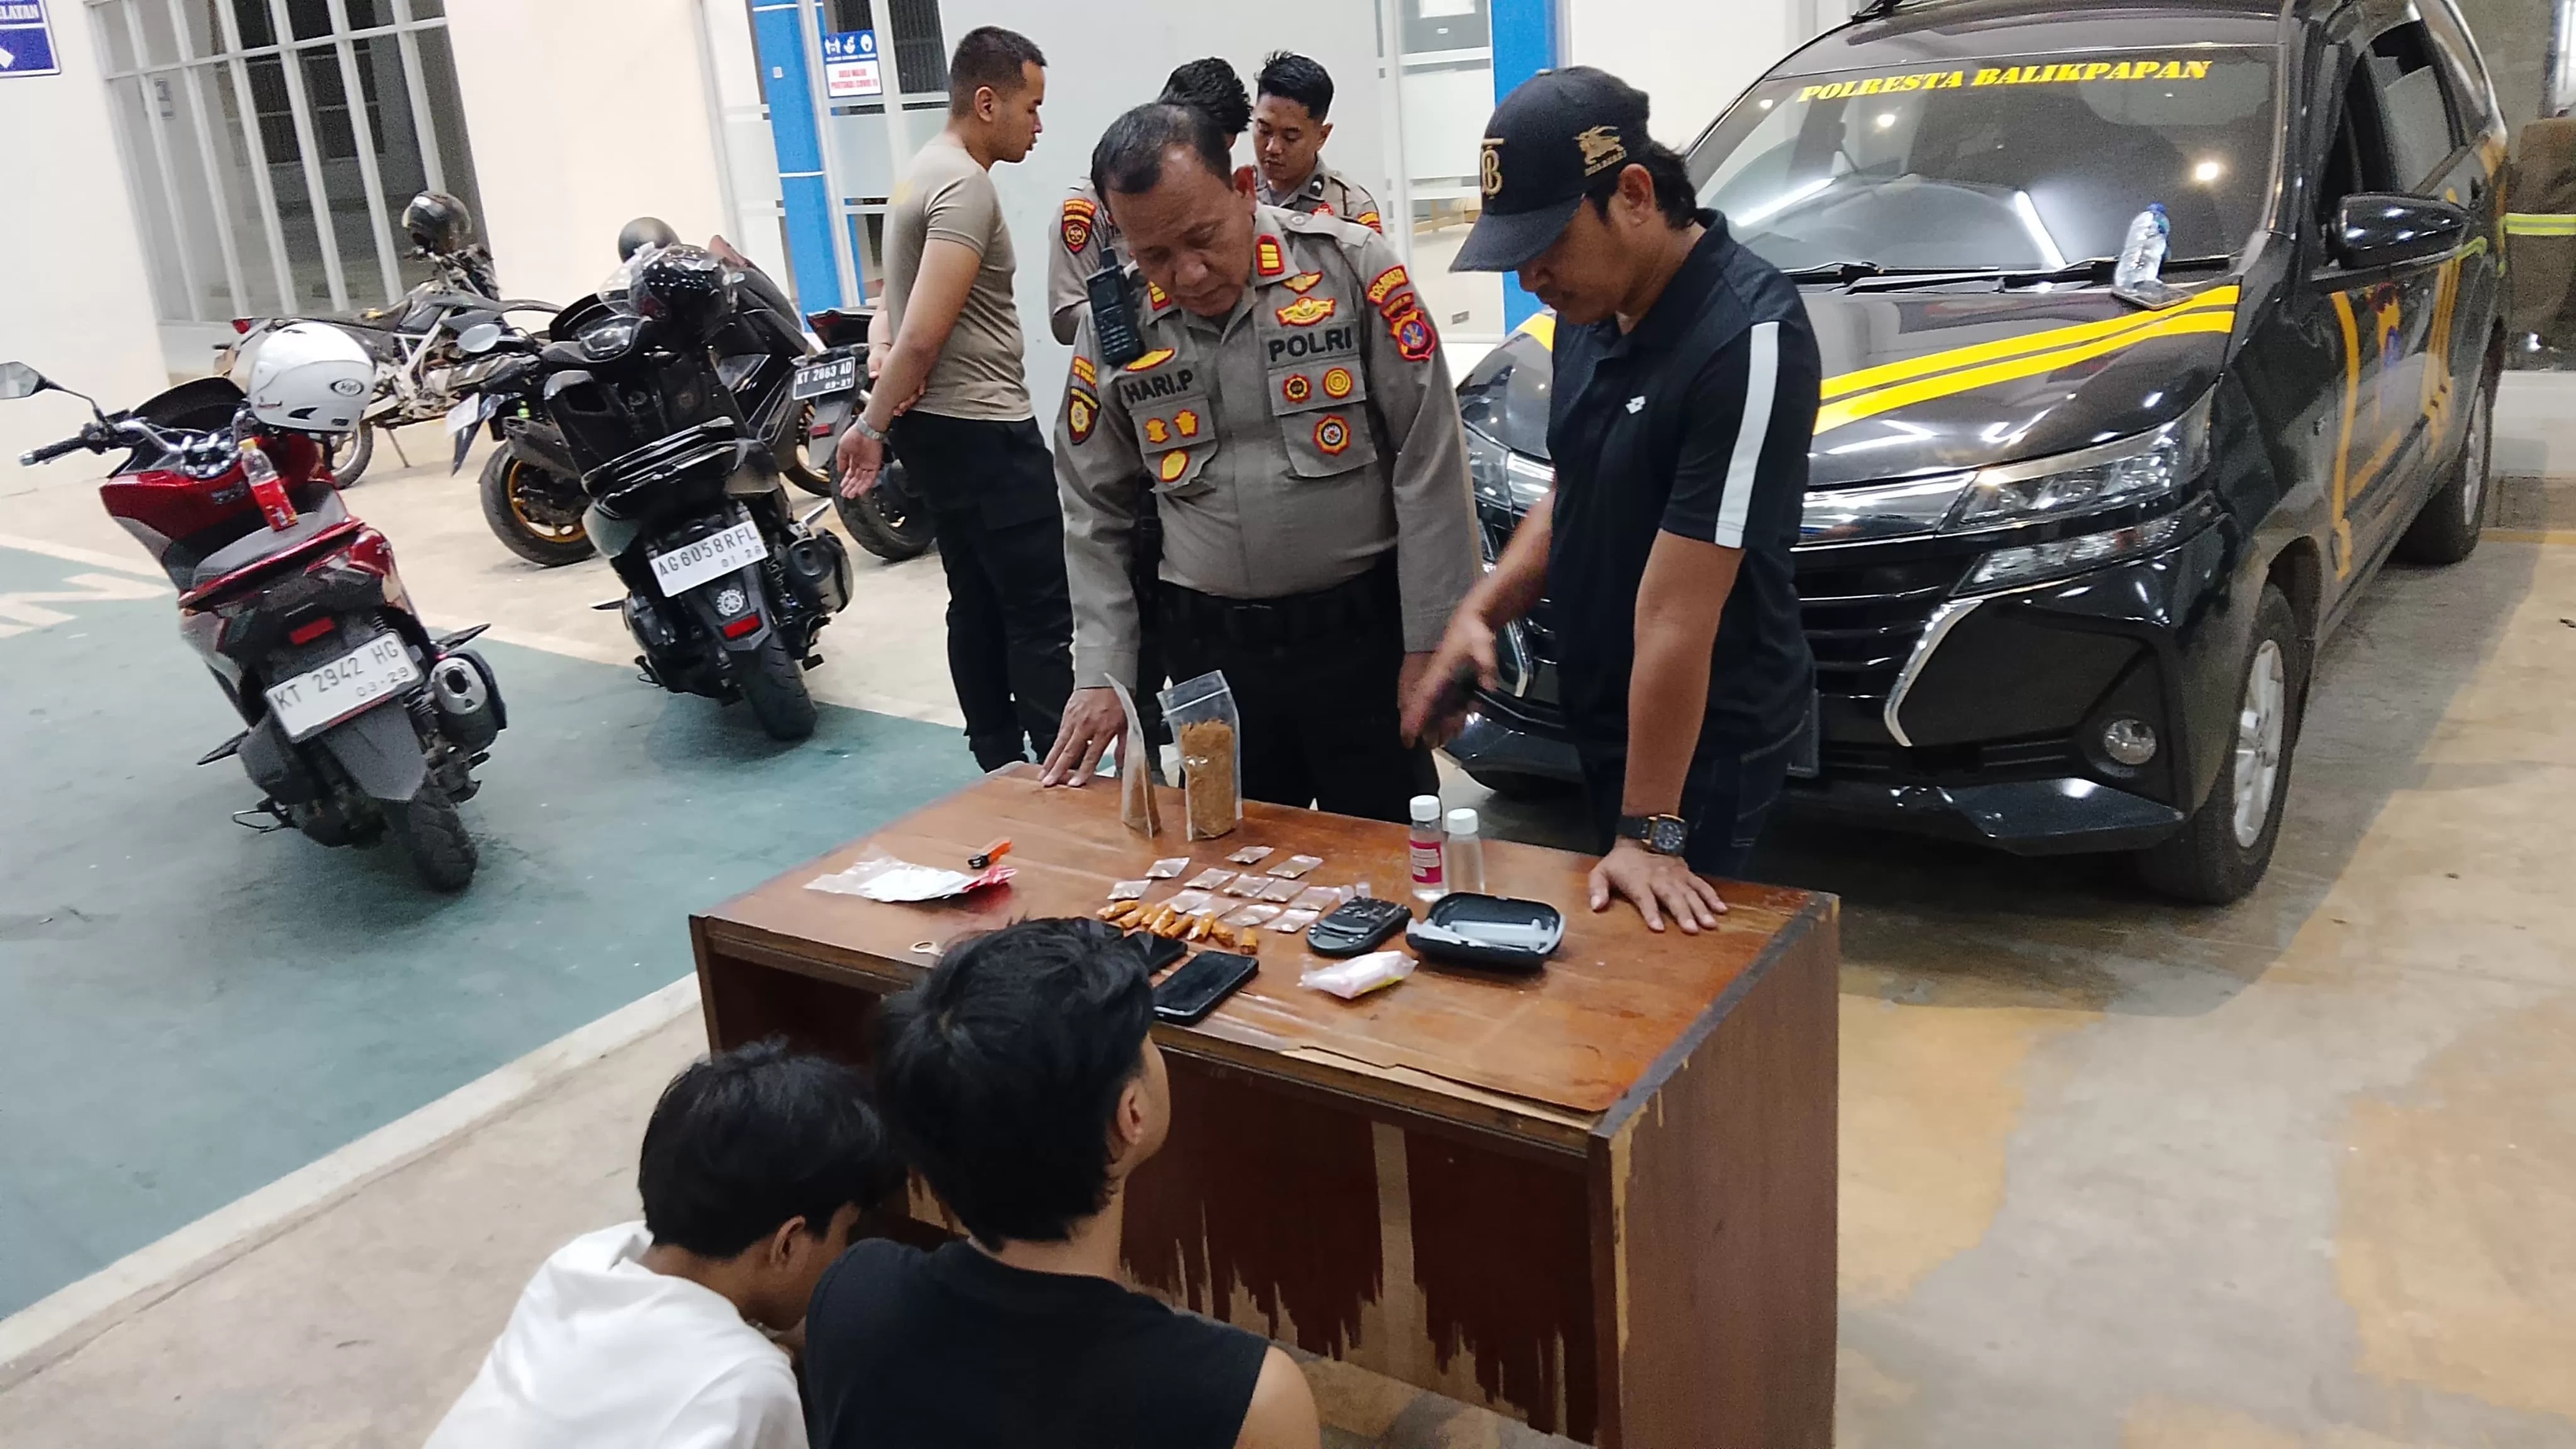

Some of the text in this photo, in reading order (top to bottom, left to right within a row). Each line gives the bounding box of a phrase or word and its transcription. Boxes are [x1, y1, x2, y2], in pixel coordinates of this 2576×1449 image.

[1796, 60, 2214, 103] POLRESTA BALIKPAPAN
[1268, 326, 1352, 362] POLRI
[797, 370, 810, 385] KT
[840, 361, 852, 375] AD
[1123, 369, 1194, 404] HARI.P
[274, 640, 399, 711] KT 2942 HG
